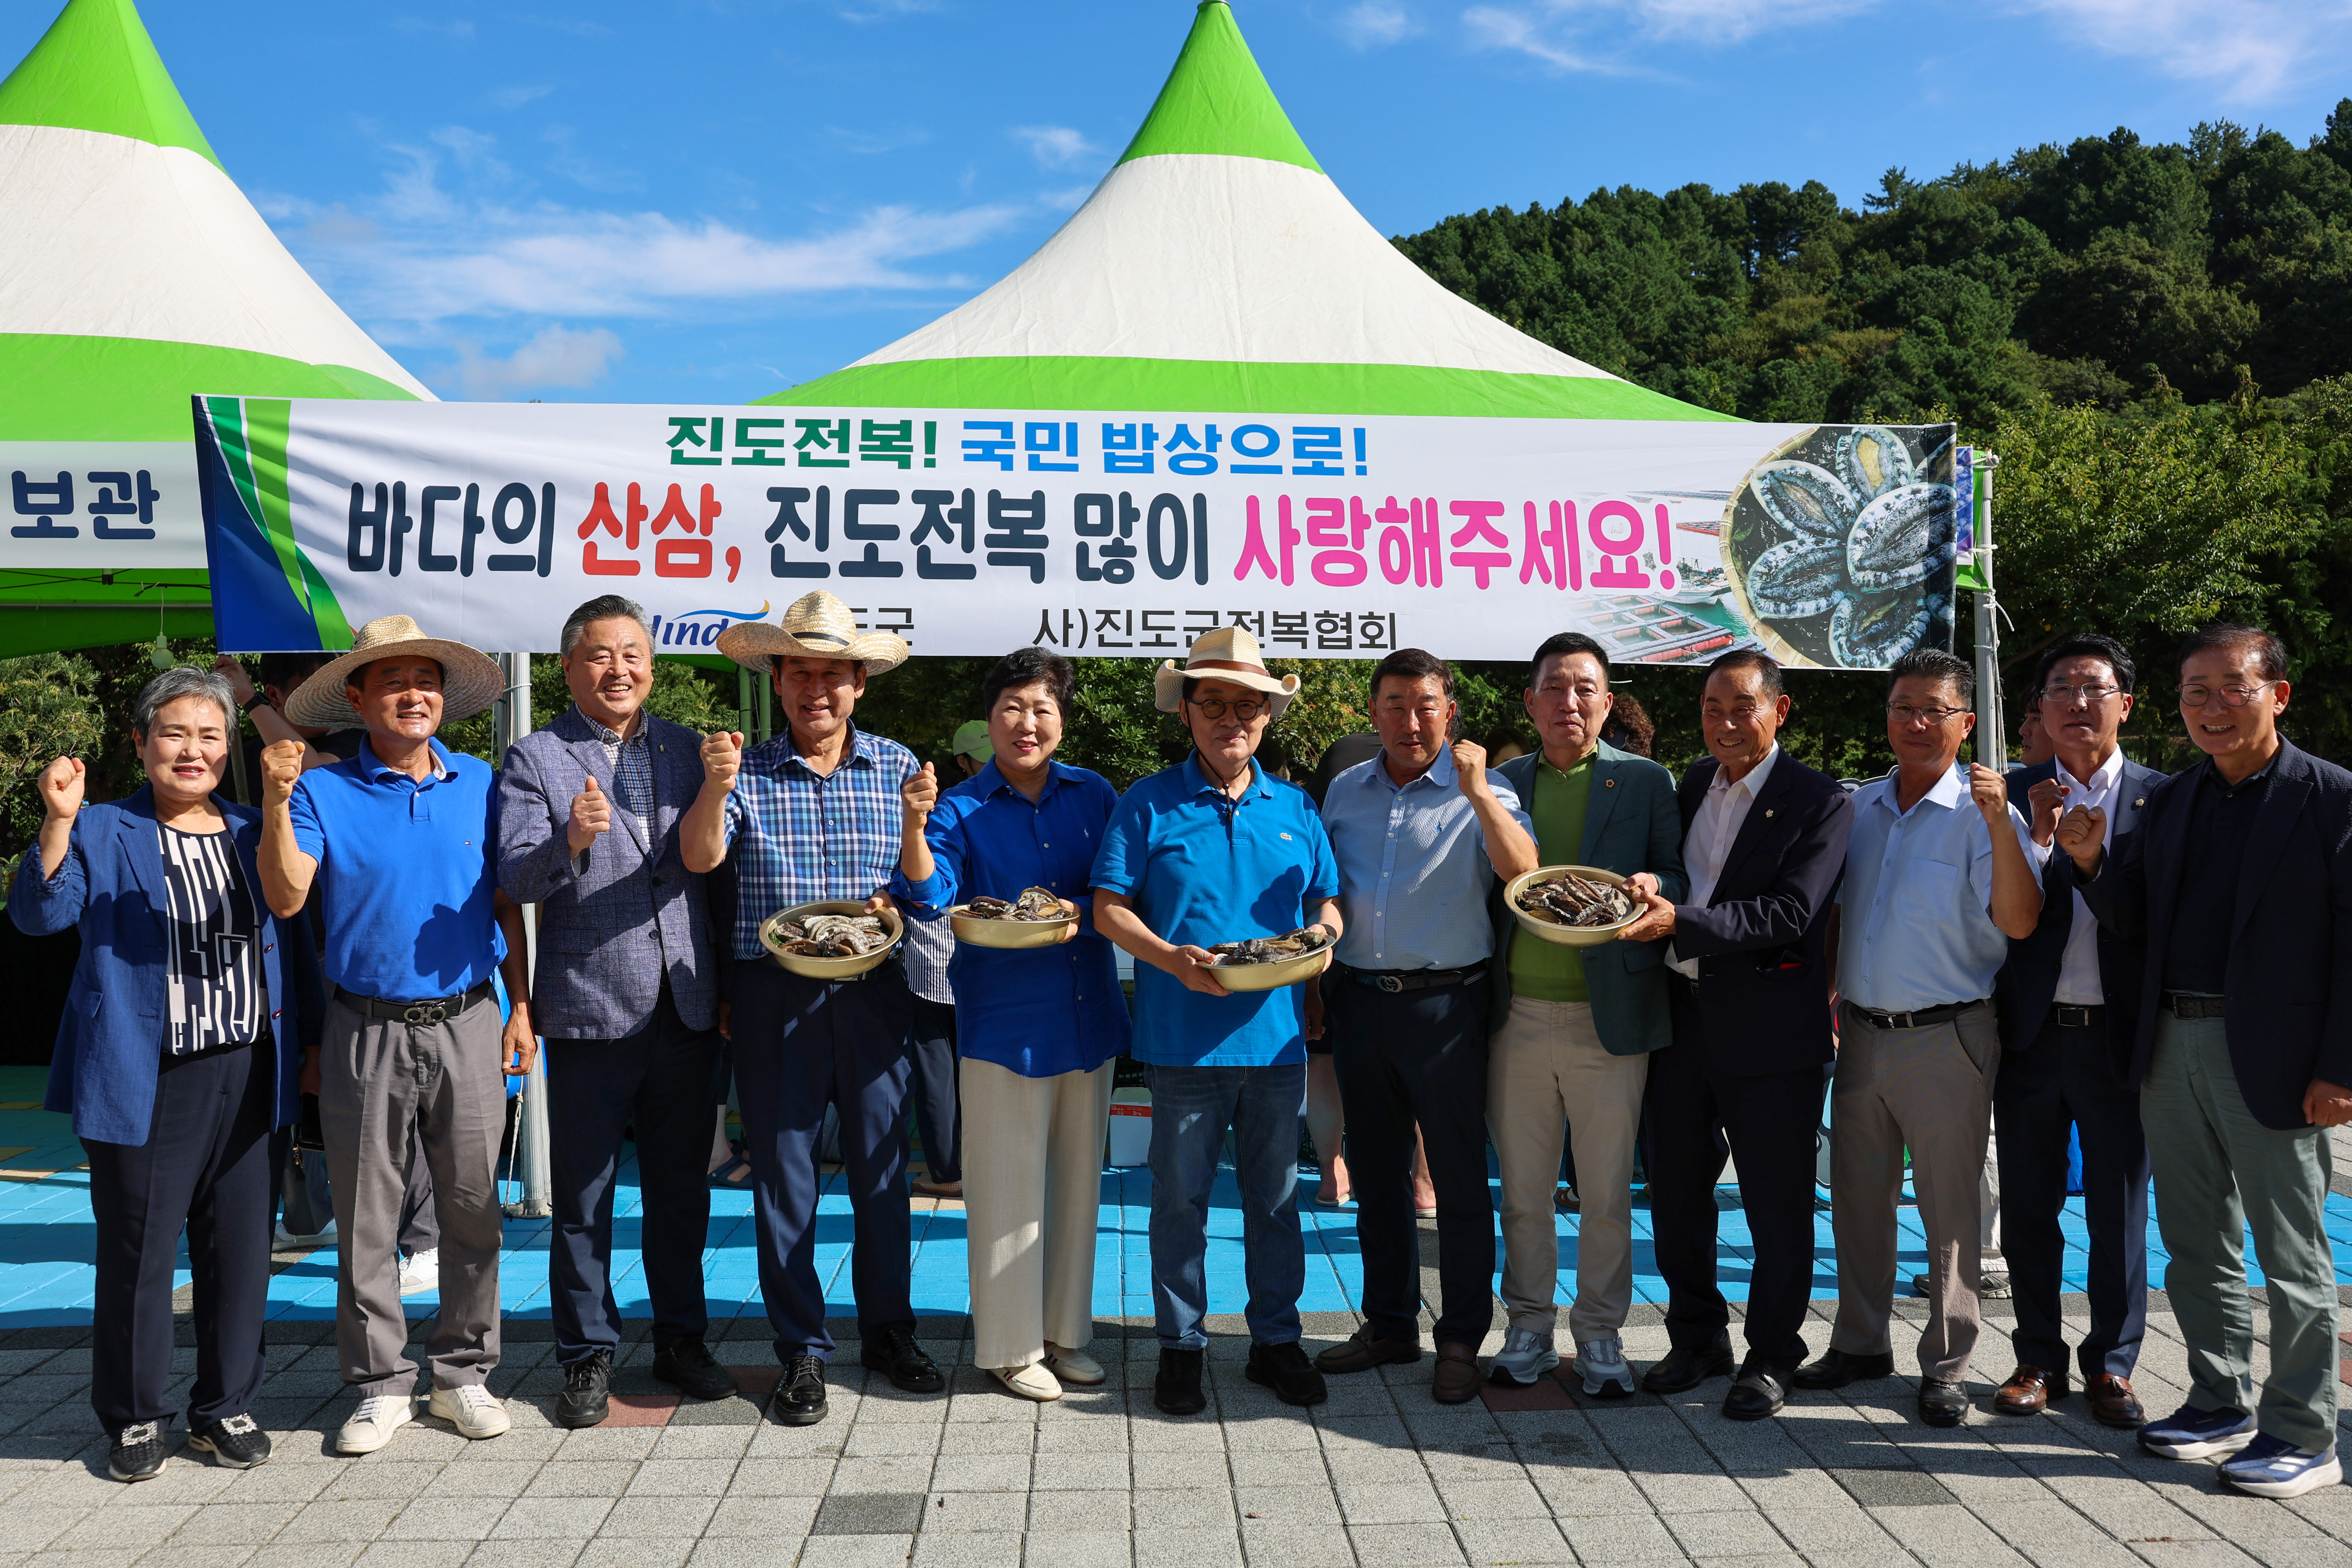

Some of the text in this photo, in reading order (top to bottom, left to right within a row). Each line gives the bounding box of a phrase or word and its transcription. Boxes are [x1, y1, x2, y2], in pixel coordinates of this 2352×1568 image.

[666, 417, 1368, 476] 진도전복! 국민 밥상으로!
[11, 470, 160, 539] 보관
[347, 481, 1677, 591] 바다의 산삼, 진도전복 많이 사랑해주세요!
